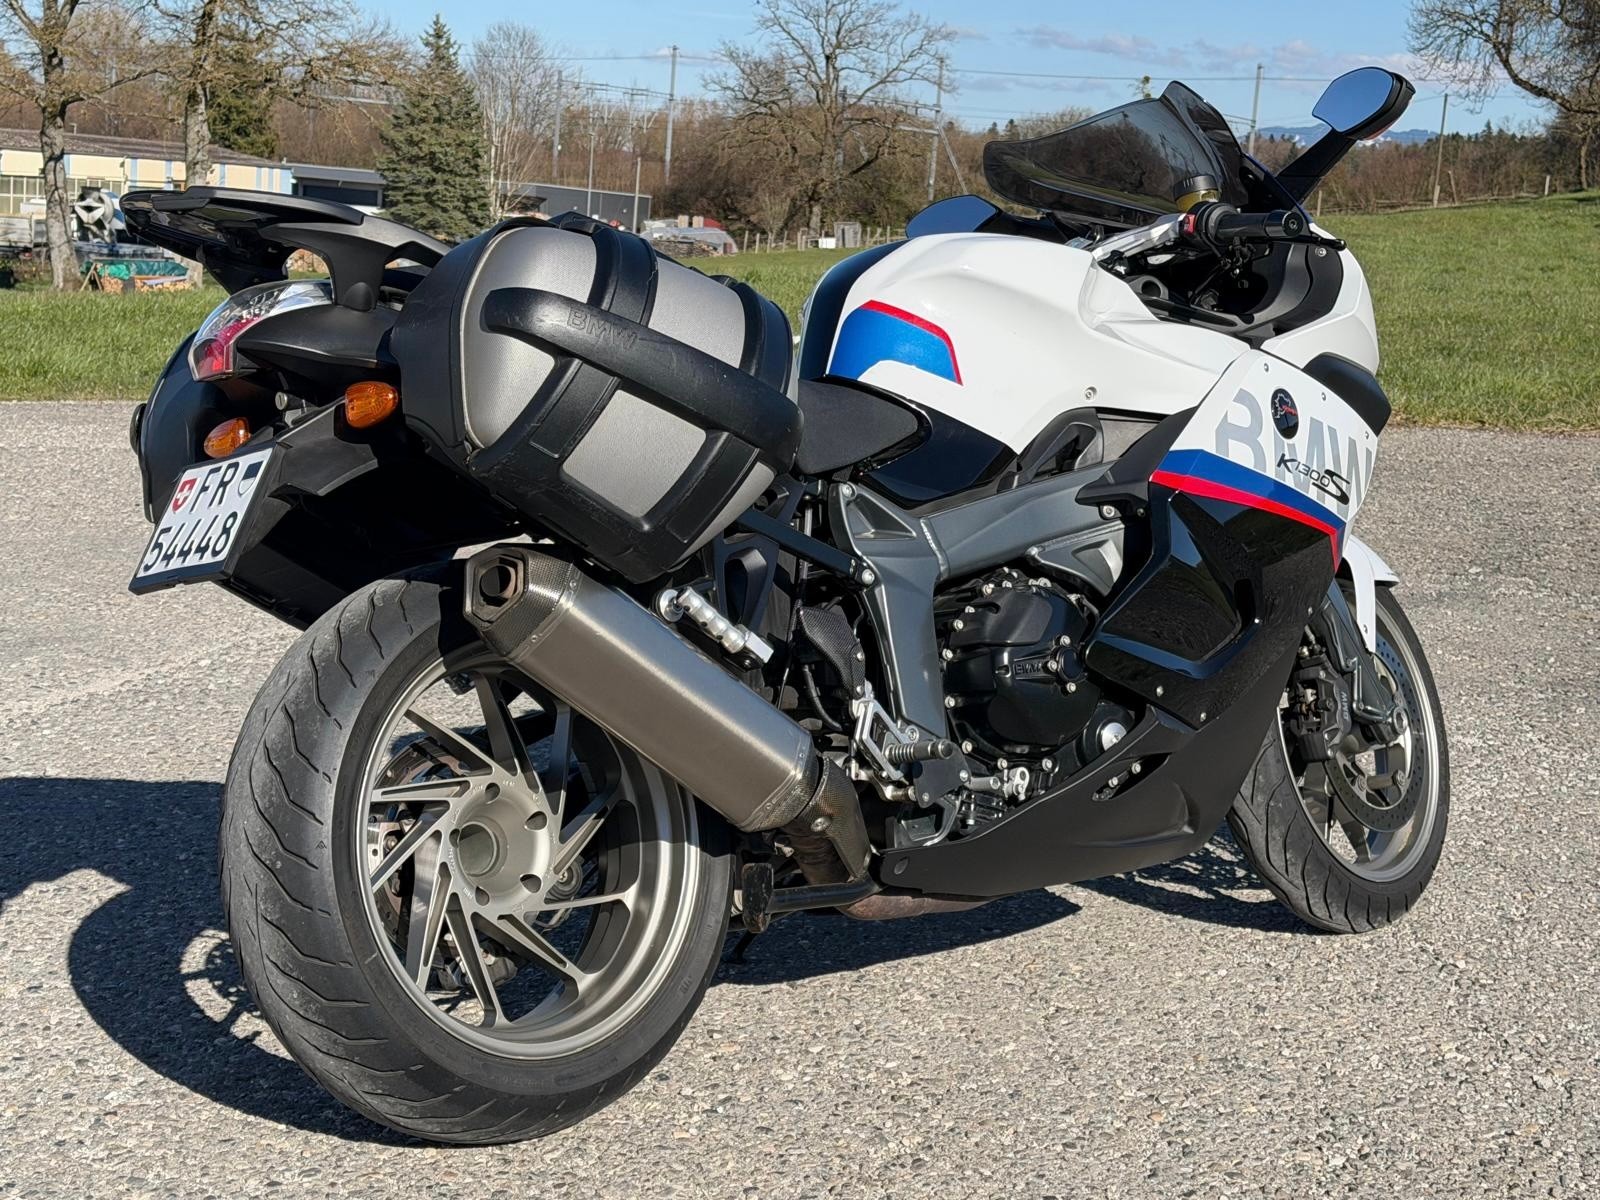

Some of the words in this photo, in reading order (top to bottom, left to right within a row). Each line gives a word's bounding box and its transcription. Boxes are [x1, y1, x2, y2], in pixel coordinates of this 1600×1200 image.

[567, 306, 637, 351] BMW
[1215, 387, 1373, 521] BMW
[190, 461, 240, 513] FR
[142, 511, 238, 572] 54448
